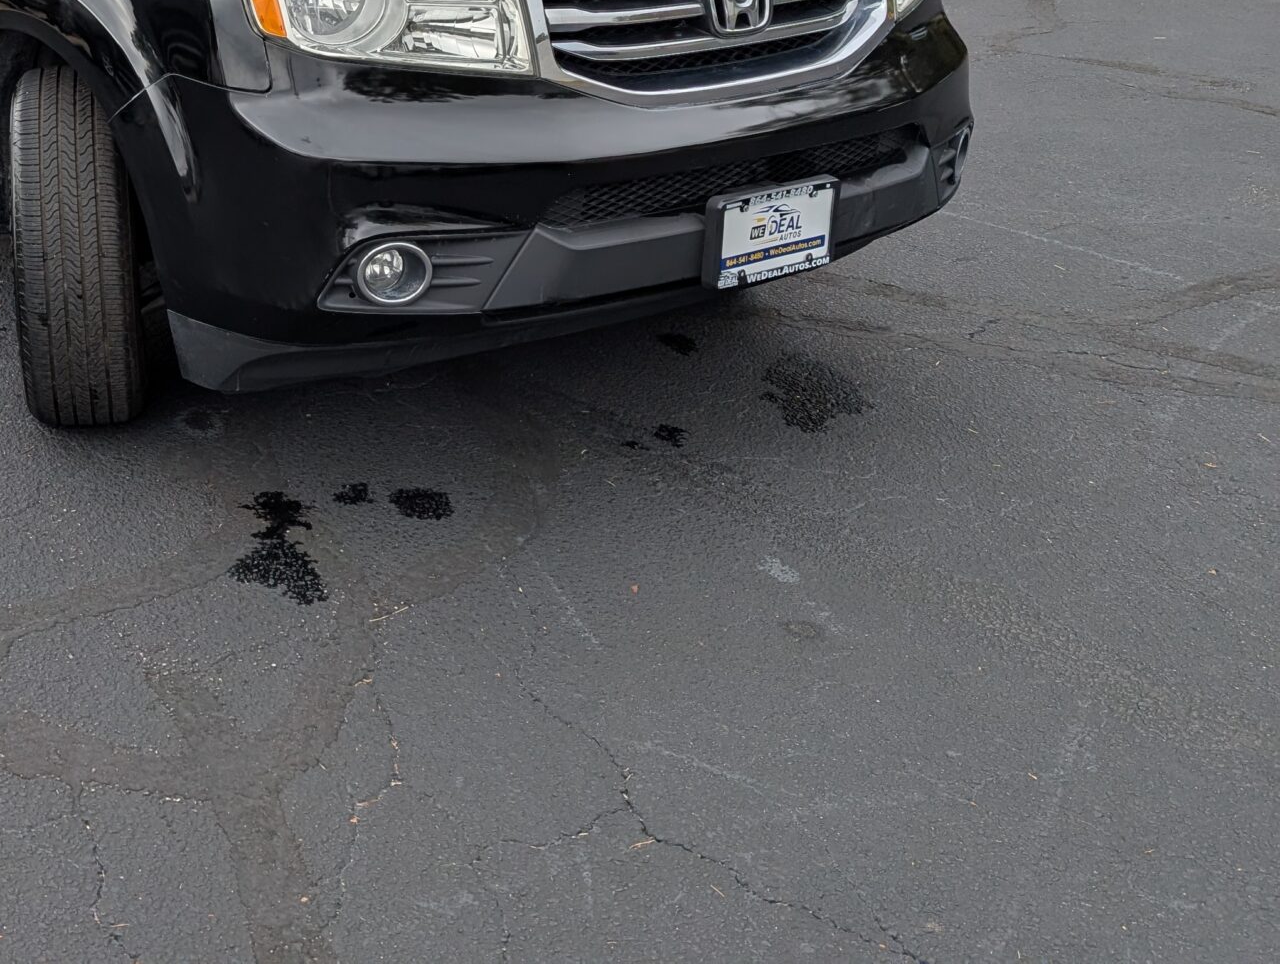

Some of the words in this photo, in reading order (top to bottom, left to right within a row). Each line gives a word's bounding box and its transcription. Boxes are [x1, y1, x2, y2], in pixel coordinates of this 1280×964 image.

[751, 225, 766, 240] WE
[768, 214, 803, 236] DEAL
[778, 230, 802, 242] AUTOS
